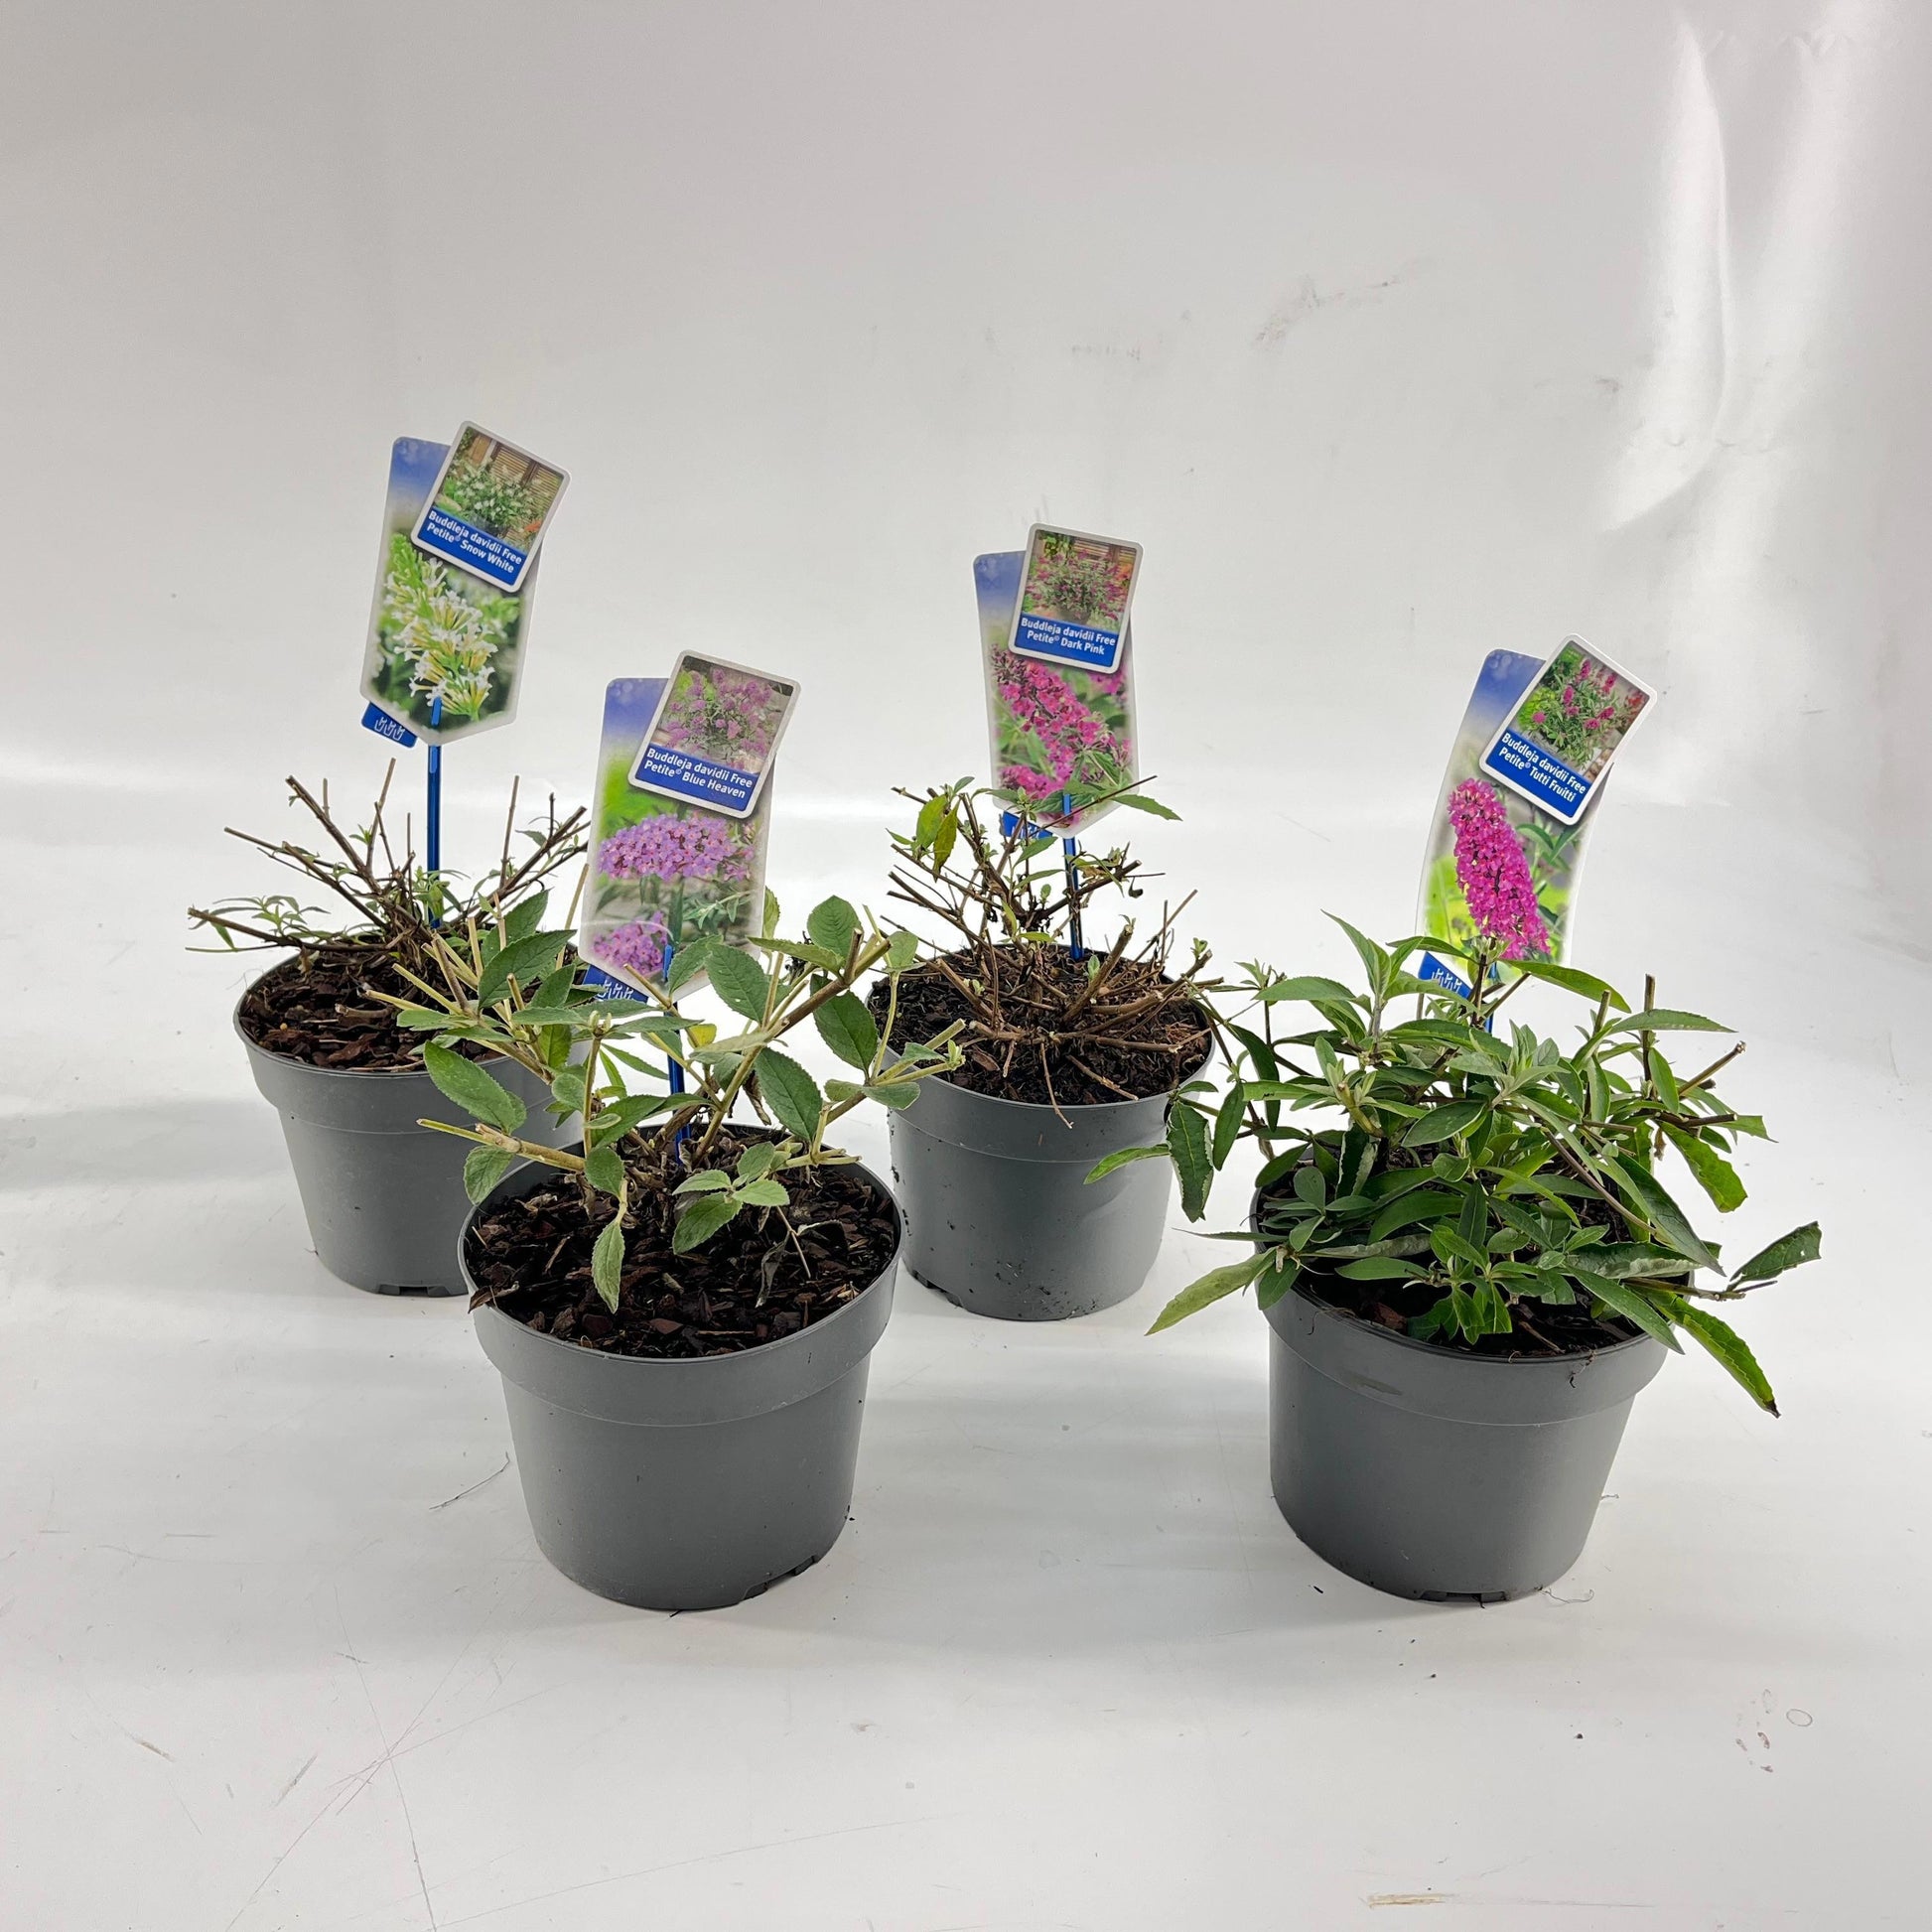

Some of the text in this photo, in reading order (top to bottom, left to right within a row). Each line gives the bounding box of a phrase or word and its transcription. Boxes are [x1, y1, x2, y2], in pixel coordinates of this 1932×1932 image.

[428, 510, 522, 565] Buddleja davidii Free
[460, 540, 486, 559] Snow
[487, 552, 514, 574] White
[1021, 618, 1116, 646] Buddleja davidii Free
[1060, 637, 1082, 650] Dark
[1083, 642, 1105, 655] Pink
[646, 748, 754, 788] Buddleja davidii Free
[1501, 733, 1587, 794] Buddleja davidii Free
[682, 771, 706, 787] Blue
[707, 778, 746, 799] Heaven
[1529, 766, 1551, 785] Tutti
[1548, 779, 1577, 802] Fruitti
